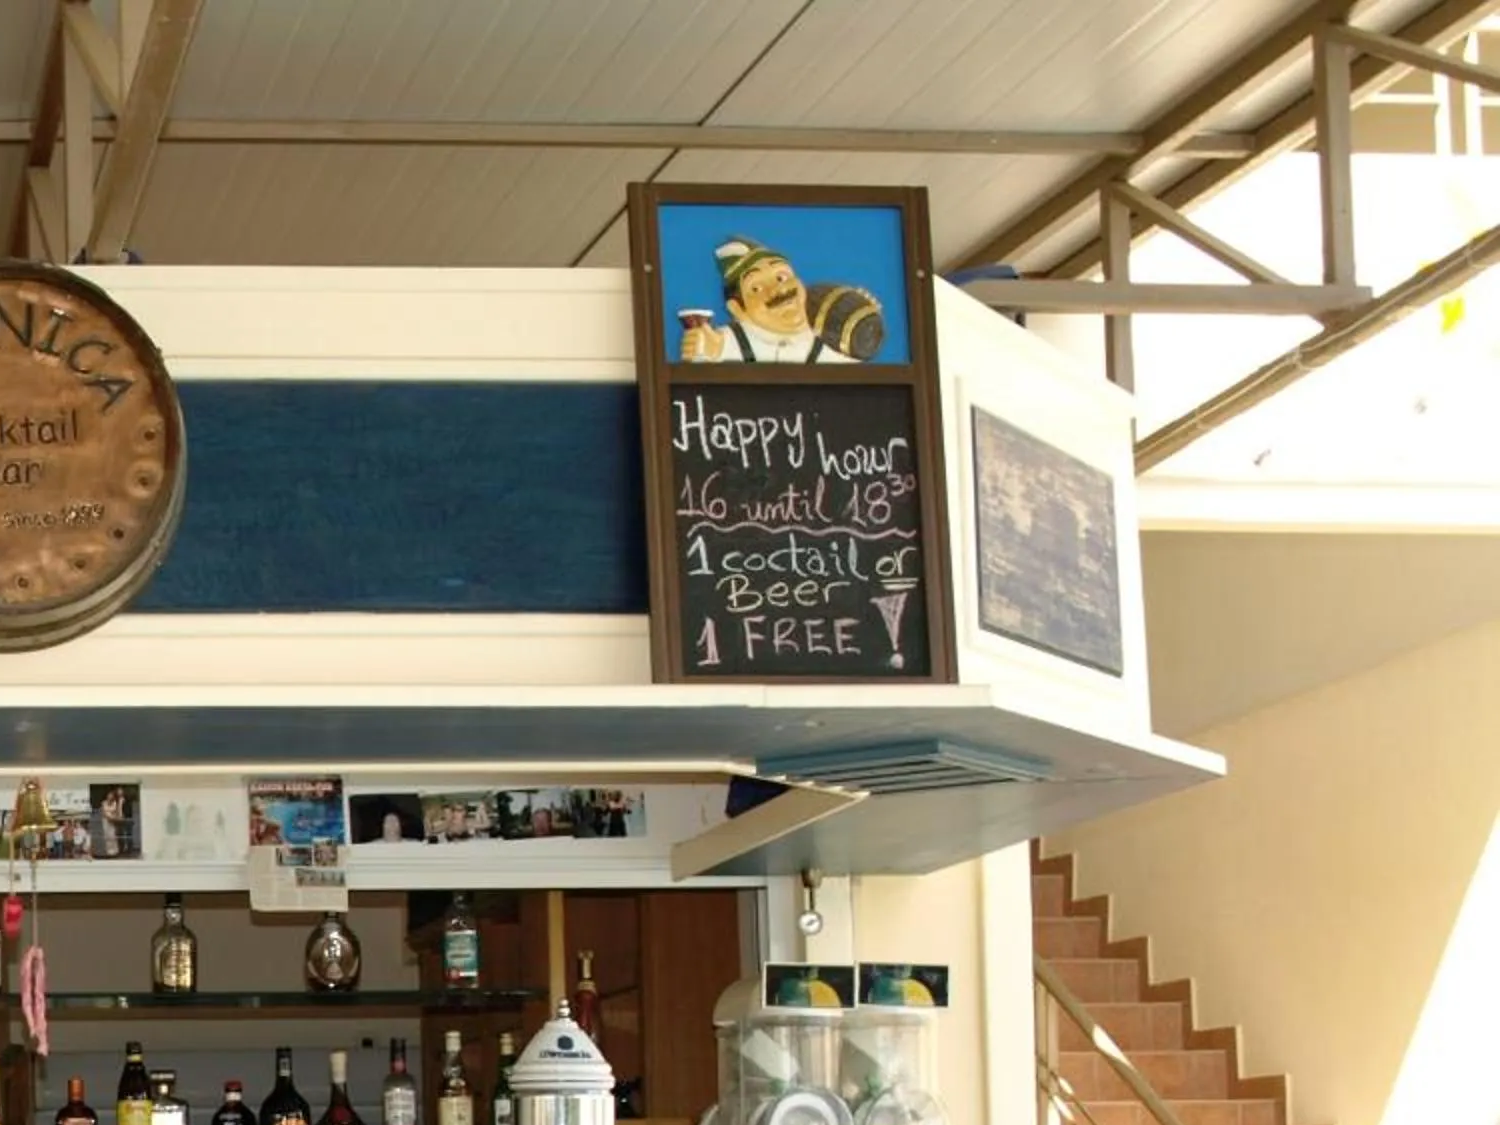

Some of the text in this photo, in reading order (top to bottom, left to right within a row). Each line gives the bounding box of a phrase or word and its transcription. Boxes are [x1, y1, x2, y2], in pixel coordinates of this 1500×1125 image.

[672, 396, 908, 480] Happy hour
[676, 471, 727, 519] 16
[740, 474, 833, 523] until
[875, 546, 918, 576] or
[715, 574, 850, 612] Beer
[696, 617, 722, 666] 1
[742, 615, 862, 660] FREE
